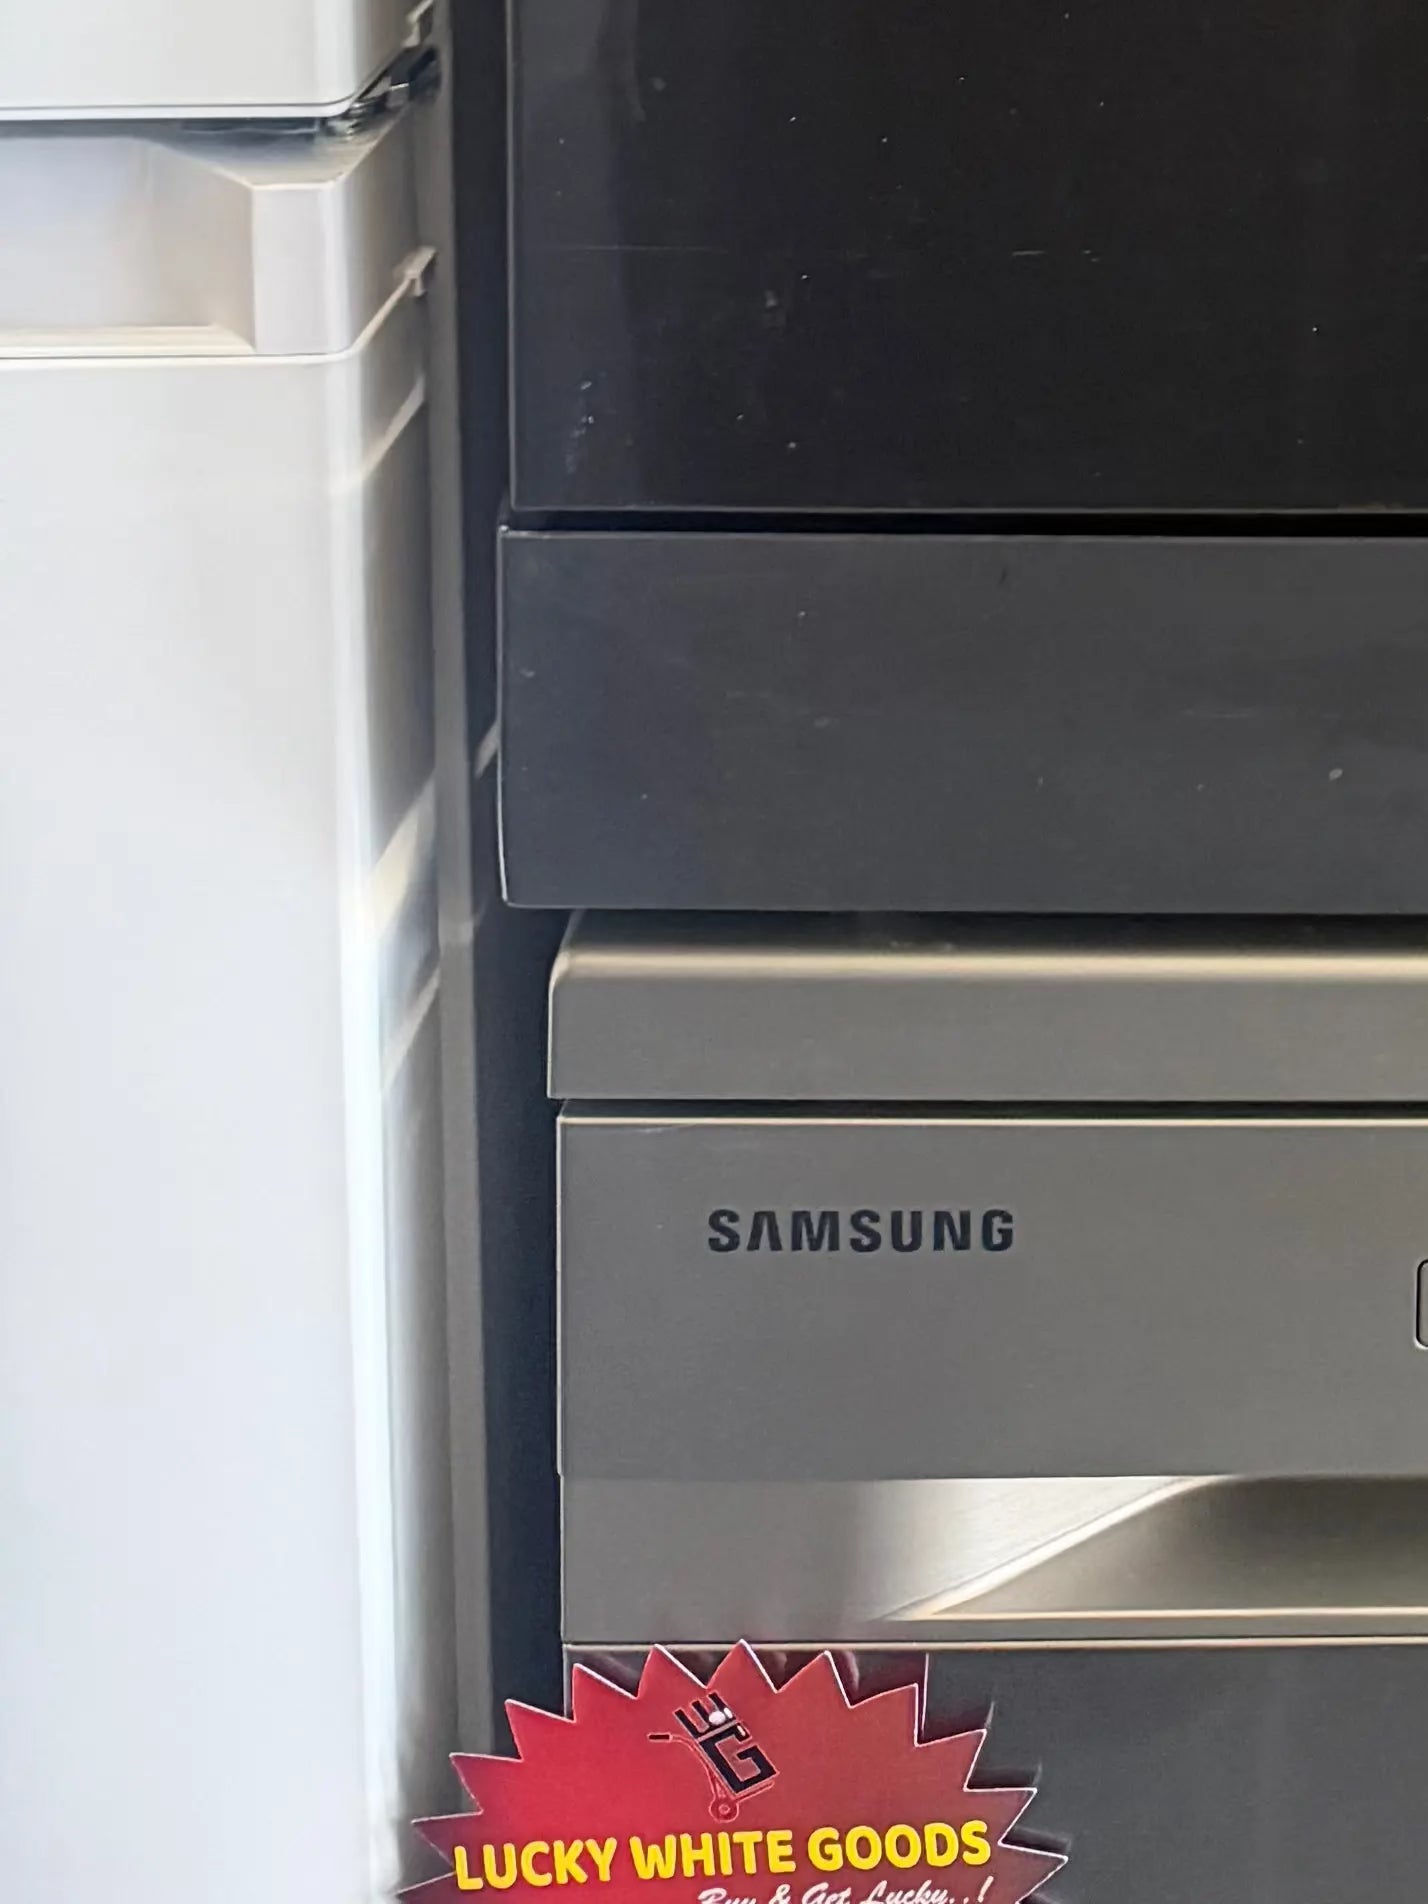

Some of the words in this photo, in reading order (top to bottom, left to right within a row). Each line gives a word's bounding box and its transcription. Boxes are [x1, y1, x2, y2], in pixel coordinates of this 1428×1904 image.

[706, 1208, 1016, 1255] SAMSUNG
[453, 1836, 618, 1892] LUCKY
[629, 1828, 797, 1881] WHITE
[807, 1819, 992, 1872] GOODS
